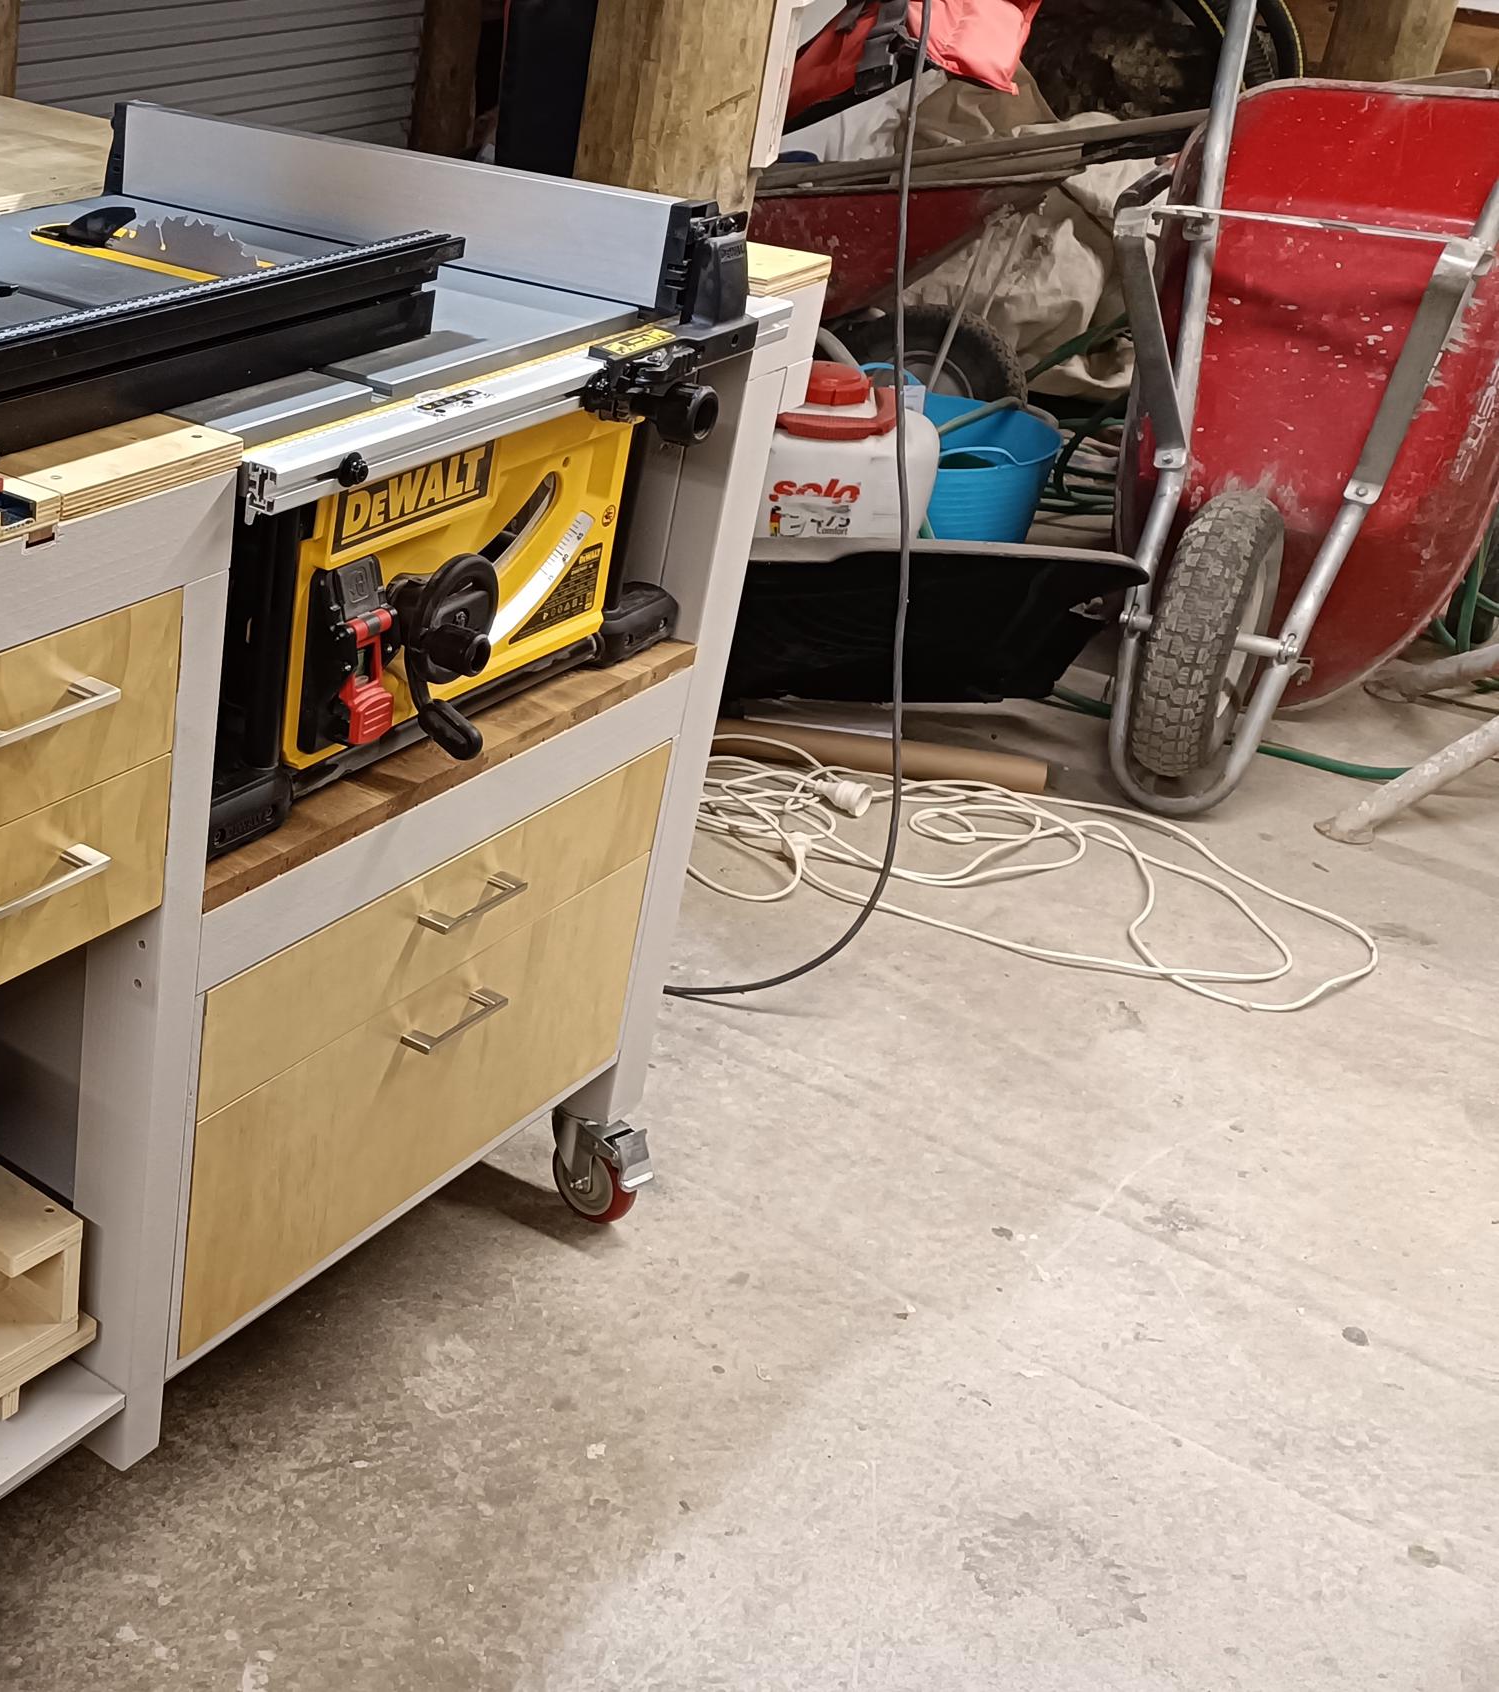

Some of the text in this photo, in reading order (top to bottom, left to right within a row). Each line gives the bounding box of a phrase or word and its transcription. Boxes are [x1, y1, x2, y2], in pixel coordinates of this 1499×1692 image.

[341, 445, 486, 538] DEWALT
[769, 478, 860, 504] solo
[816, 527, 849, 535] Comfort
